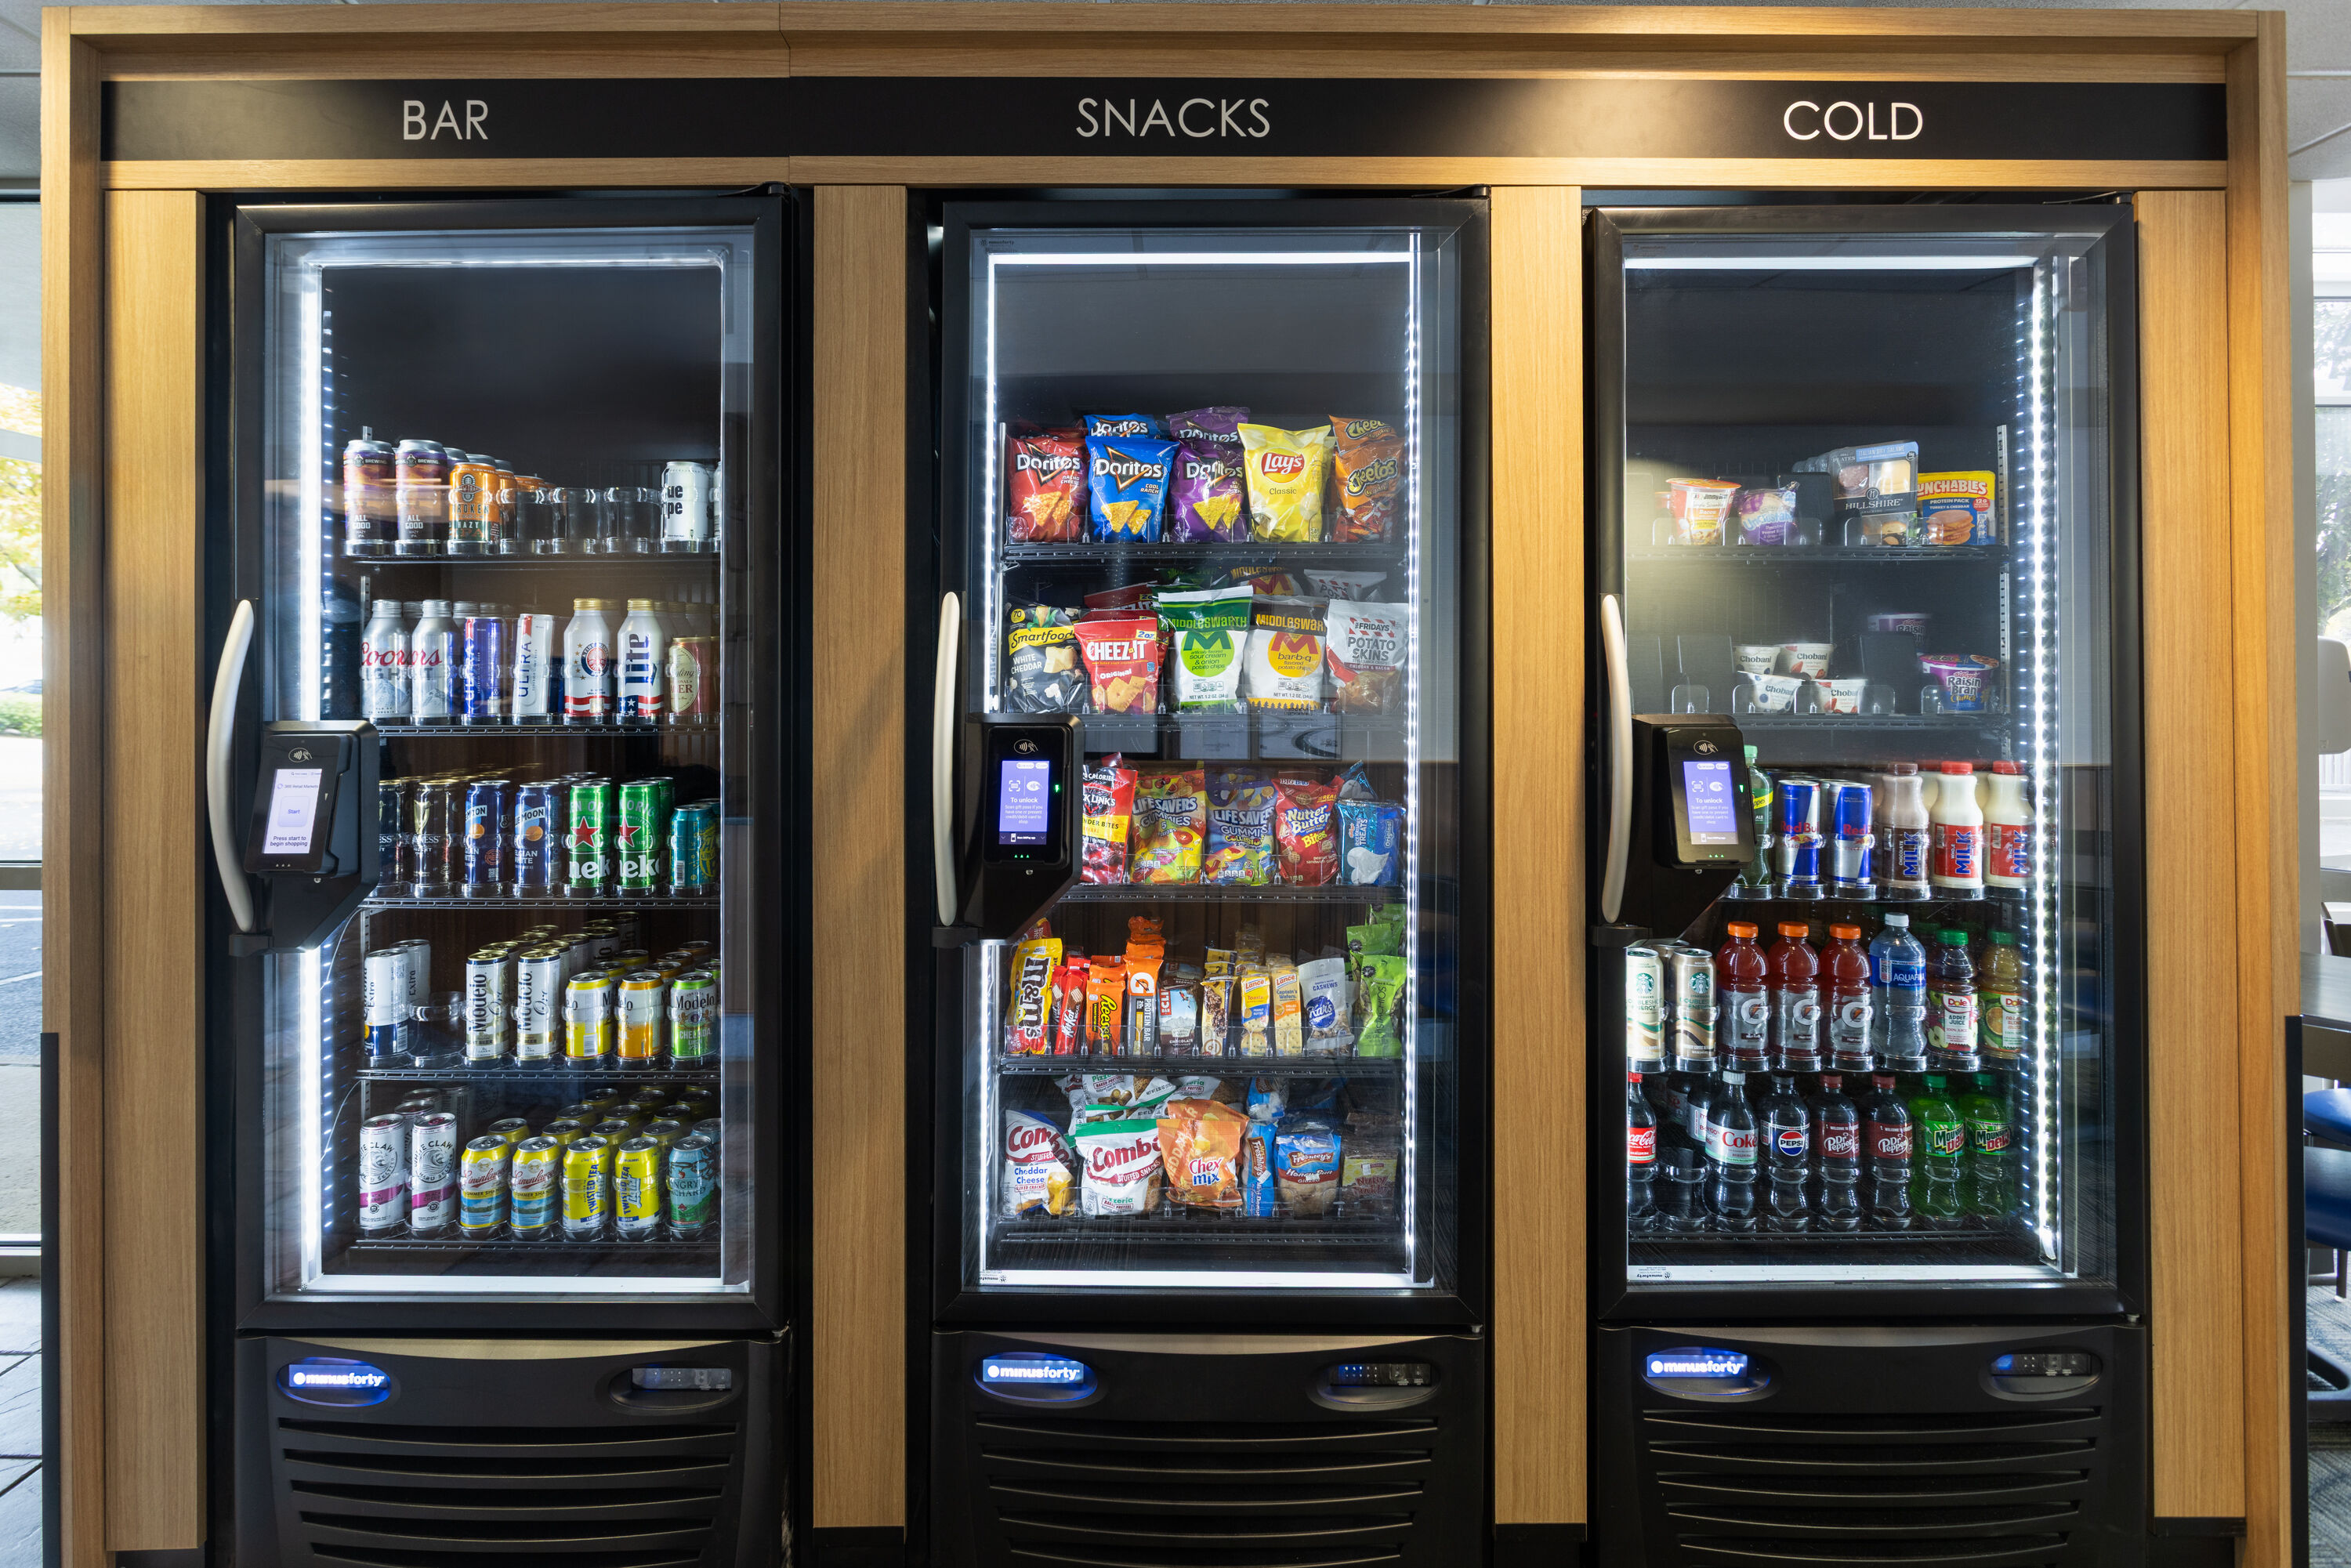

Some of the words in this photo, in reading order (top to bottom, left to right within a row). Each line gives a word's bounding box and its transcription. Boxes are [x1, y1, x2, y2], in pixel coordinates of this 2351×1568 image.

[403, 100, 489, 140] BAR
[1075, 97, 1271, 138] SNACKS
[1783, 100, 1924, 141] COLD
[1017, 454, 1080, 471] Doritos
[1095, 458, 1163, 479] Doritos
[1186, 461, 1243, 480] Doritos
[1263, 452, 1303, 475] Lay's
[1917, 479, 1988, 497] UNCHABLES
[1846, 500, 1900, 510] HILLSHIRE
[1359, 622, 1390, 632] FRIDAYS
[1010, 628, 1074, 648] Smartfood
[1347, 636, 1396, 651] POTATO
[1012, 653, 1036, 664] WHITE
[1085, 640, 1147, 661] CHEEZ-IT
[1352, 647, 1389, 661] SKINS
[518, 640, 532, 697] ULTRA
[1011, 661, 1042, 675] CHEDDAR
[1946, 675, 1982, 688] Raisin
[1951, 686, 1978, 697] Bran
[1132, 797, 1154, 815] LIFE
[1154, 797, 1197, 813] SAVERS
[1288, 804, 1328, 822] Nutter
[522, 809, 545, 821] MOON
[1140, 810, 1191, 827] GUMMIES
[1215, 809, 1238, 824] LIFE
[1291, 813, 1331, 834] Butter
[1100, 821, 1119, 830] BITES
[1359, 819, 1367, 846] TREATS
[1384, 820, 1393, 848] Original
[1780, 820, 1802, 833] Red
[1843, 824, 1867, 835] Red
[1301, 831, 1328, 849] Bites
[1903, 831, 1920, 876] MILK
[1955, 829, 1972, 875] MILK
[2012, 829, 2028, 875] MILK
[1245, 979, 1265, 989] Lance
[1276, 974, 1295, 986] Lance
[1312, 982, 1339, 991] CASHEWS
[675, 994, 715, 1011] Modelo
[1309, 1002, 1333, 1019] Kar's
[1947, 998, 1968, 1006] Dole
[428, 1140, 454, 1150] CLAW
[1722, 1131, 1758, 1148] Coke
[1824, 1137, 1854, 1153] Pepper
[1878, 1139, 1908, 1153] Pepper
[1030, 1151, 1054, 1161] STUFFED
[1252, 1140, 1263, 1176] Freshley's
[588, 1164, 600, 1178] TEA
[1014, 1167, 1048, 1175] Cheddar
[1117, 1173, 1139, 1182] STUFFED
[1140, 1160, 1161, 1176] SNACKS
[1189, 1157, 1223, 1175] Chex
[1192, 1171, 1220, 1186] mix
[586, 1177, 600, 1214] TWISTED
[621, 1181, 632, 1215] TWISTED
[999, 1366, 1077, 1381] minusforty
[1663, 1360, 1742, 1375] minusforty
